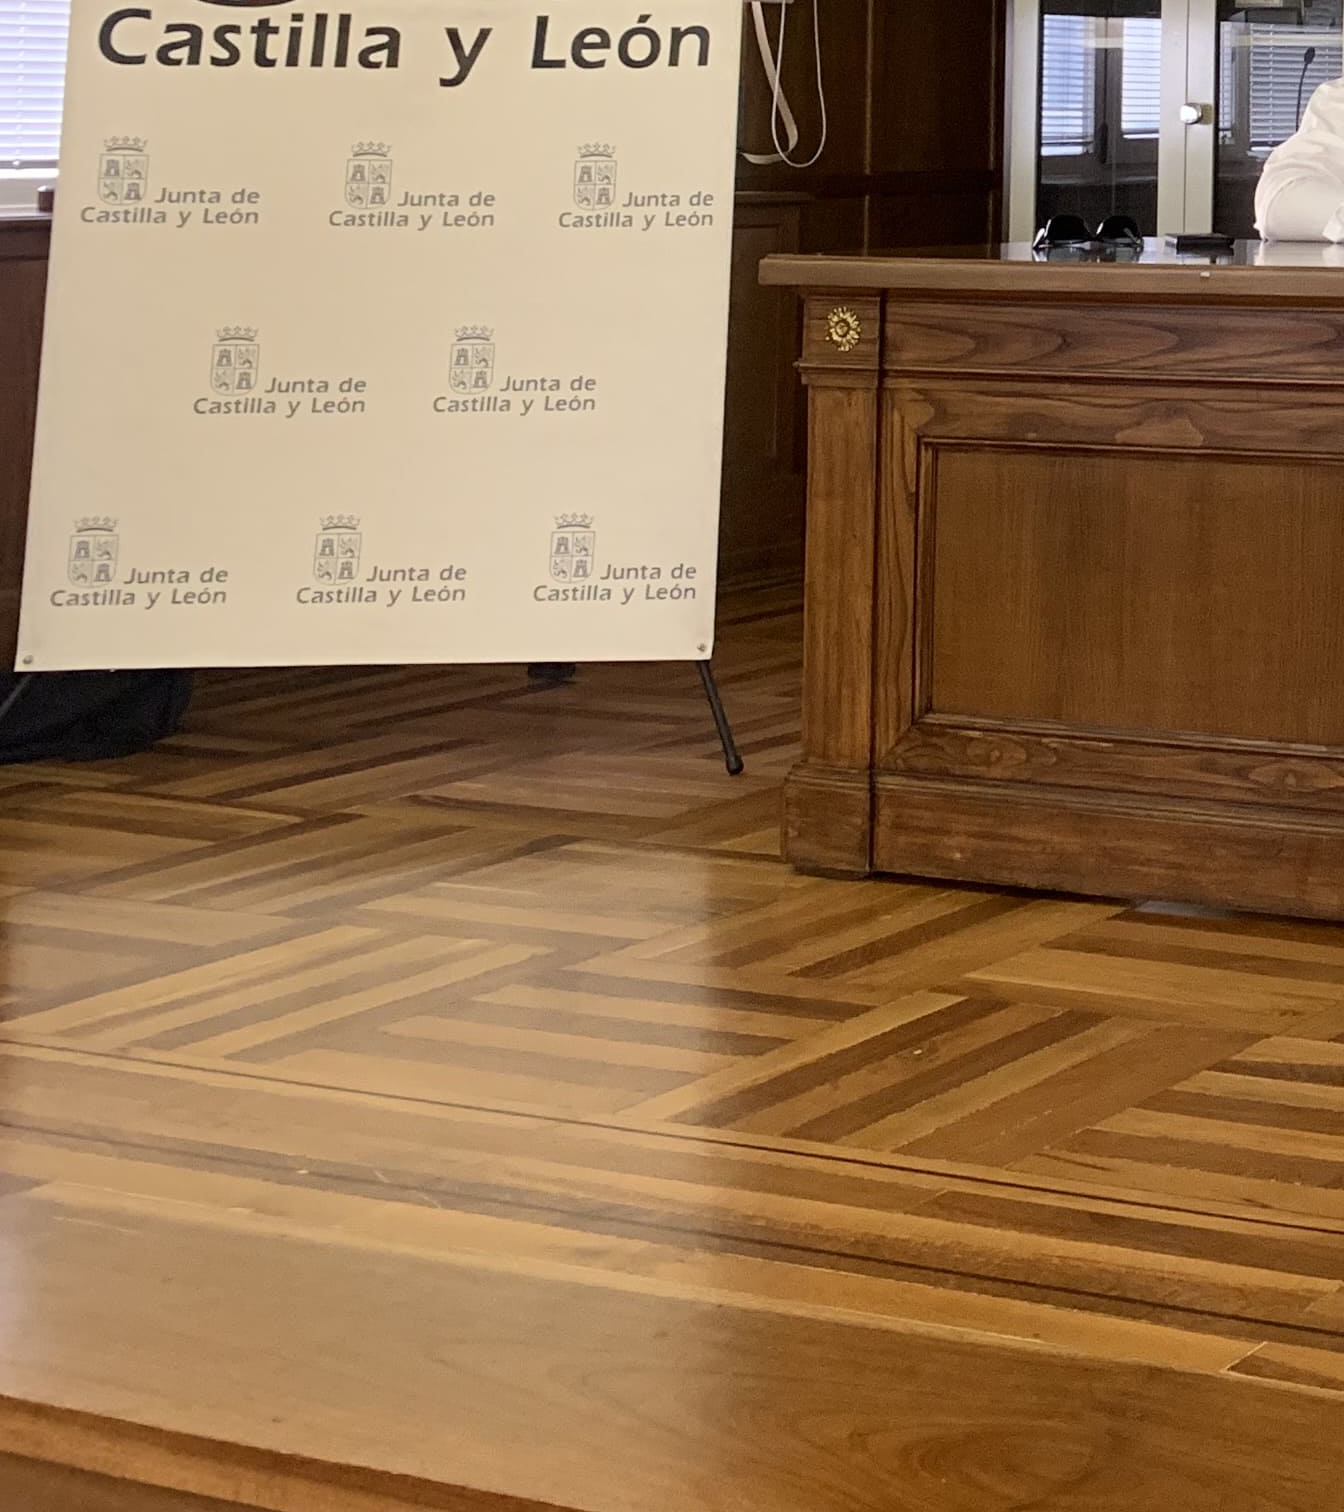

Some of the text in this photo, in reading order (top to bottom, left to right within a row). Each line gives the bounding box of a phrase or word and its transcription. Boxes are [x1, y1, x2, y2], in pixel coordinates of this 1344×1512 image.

[99, 8, 710, 87] Castilla y León
[154, 188, 260, 204] Junta de
[397, 192, 495, 207] Junta de
[622, 191, 714, 207] Junta de
[81, 207, 258, 228] Castilla y León
[329, 211, 494, 231] Castilla y León
[559, 211, 713, 231] Castilla y León
[264, 377, 366, 393] Junta de
[500, 376, 596, 392] Junta de
[194, 397, 365, 418] Castilla y León
[433, 395, 595, 416] Castilla y León
[124, 567, 228, 584] Junta de
[366, 565, 466, 582] Junta de
[600, 563, 696, 580] Junta de
[50, 588, 226, 610] Castilla y León
[297, 586, 465, 607] Castilla y León
[534, 584, 696, 605] Castilla y León
